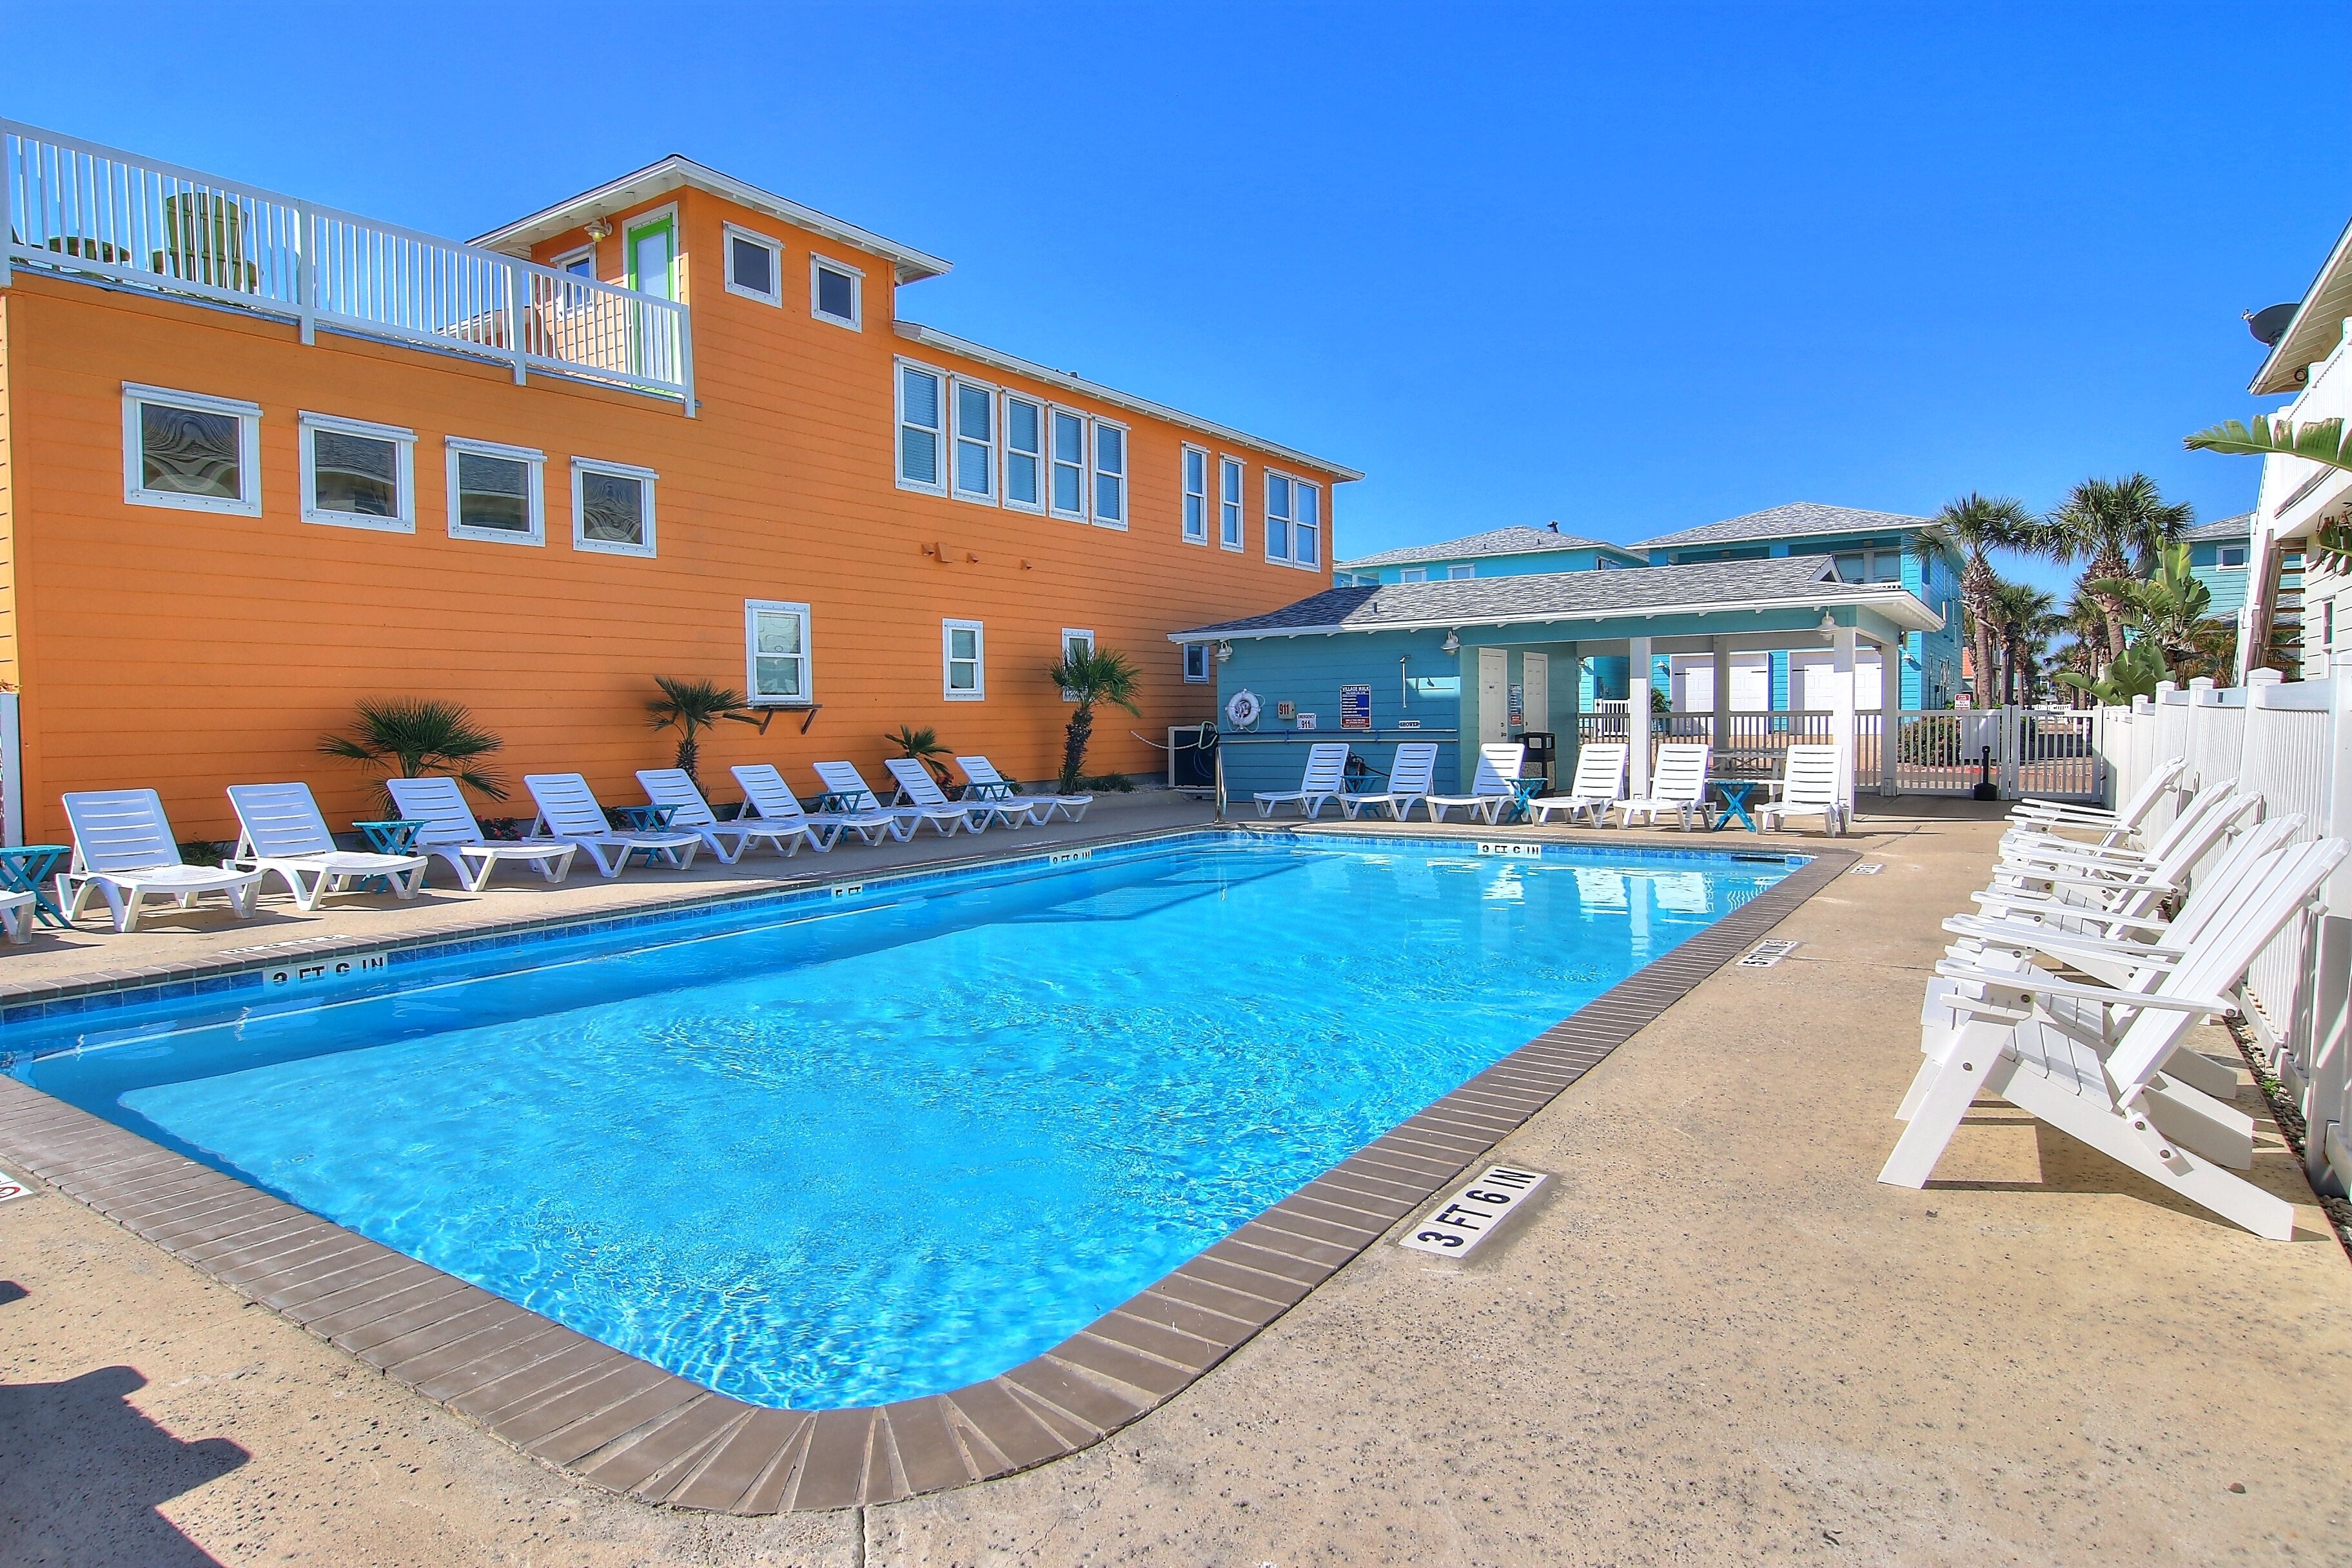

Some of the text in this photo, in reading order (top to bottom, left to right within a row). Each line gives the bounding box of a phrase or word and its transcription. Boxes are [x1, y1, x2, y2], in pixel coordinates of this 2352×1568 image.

[1279, 704, 1289, 714] 911
[1301, 720, 1310, 729] 911
[1417, 1169, 1536, 1247] 3 FT 6 IN
